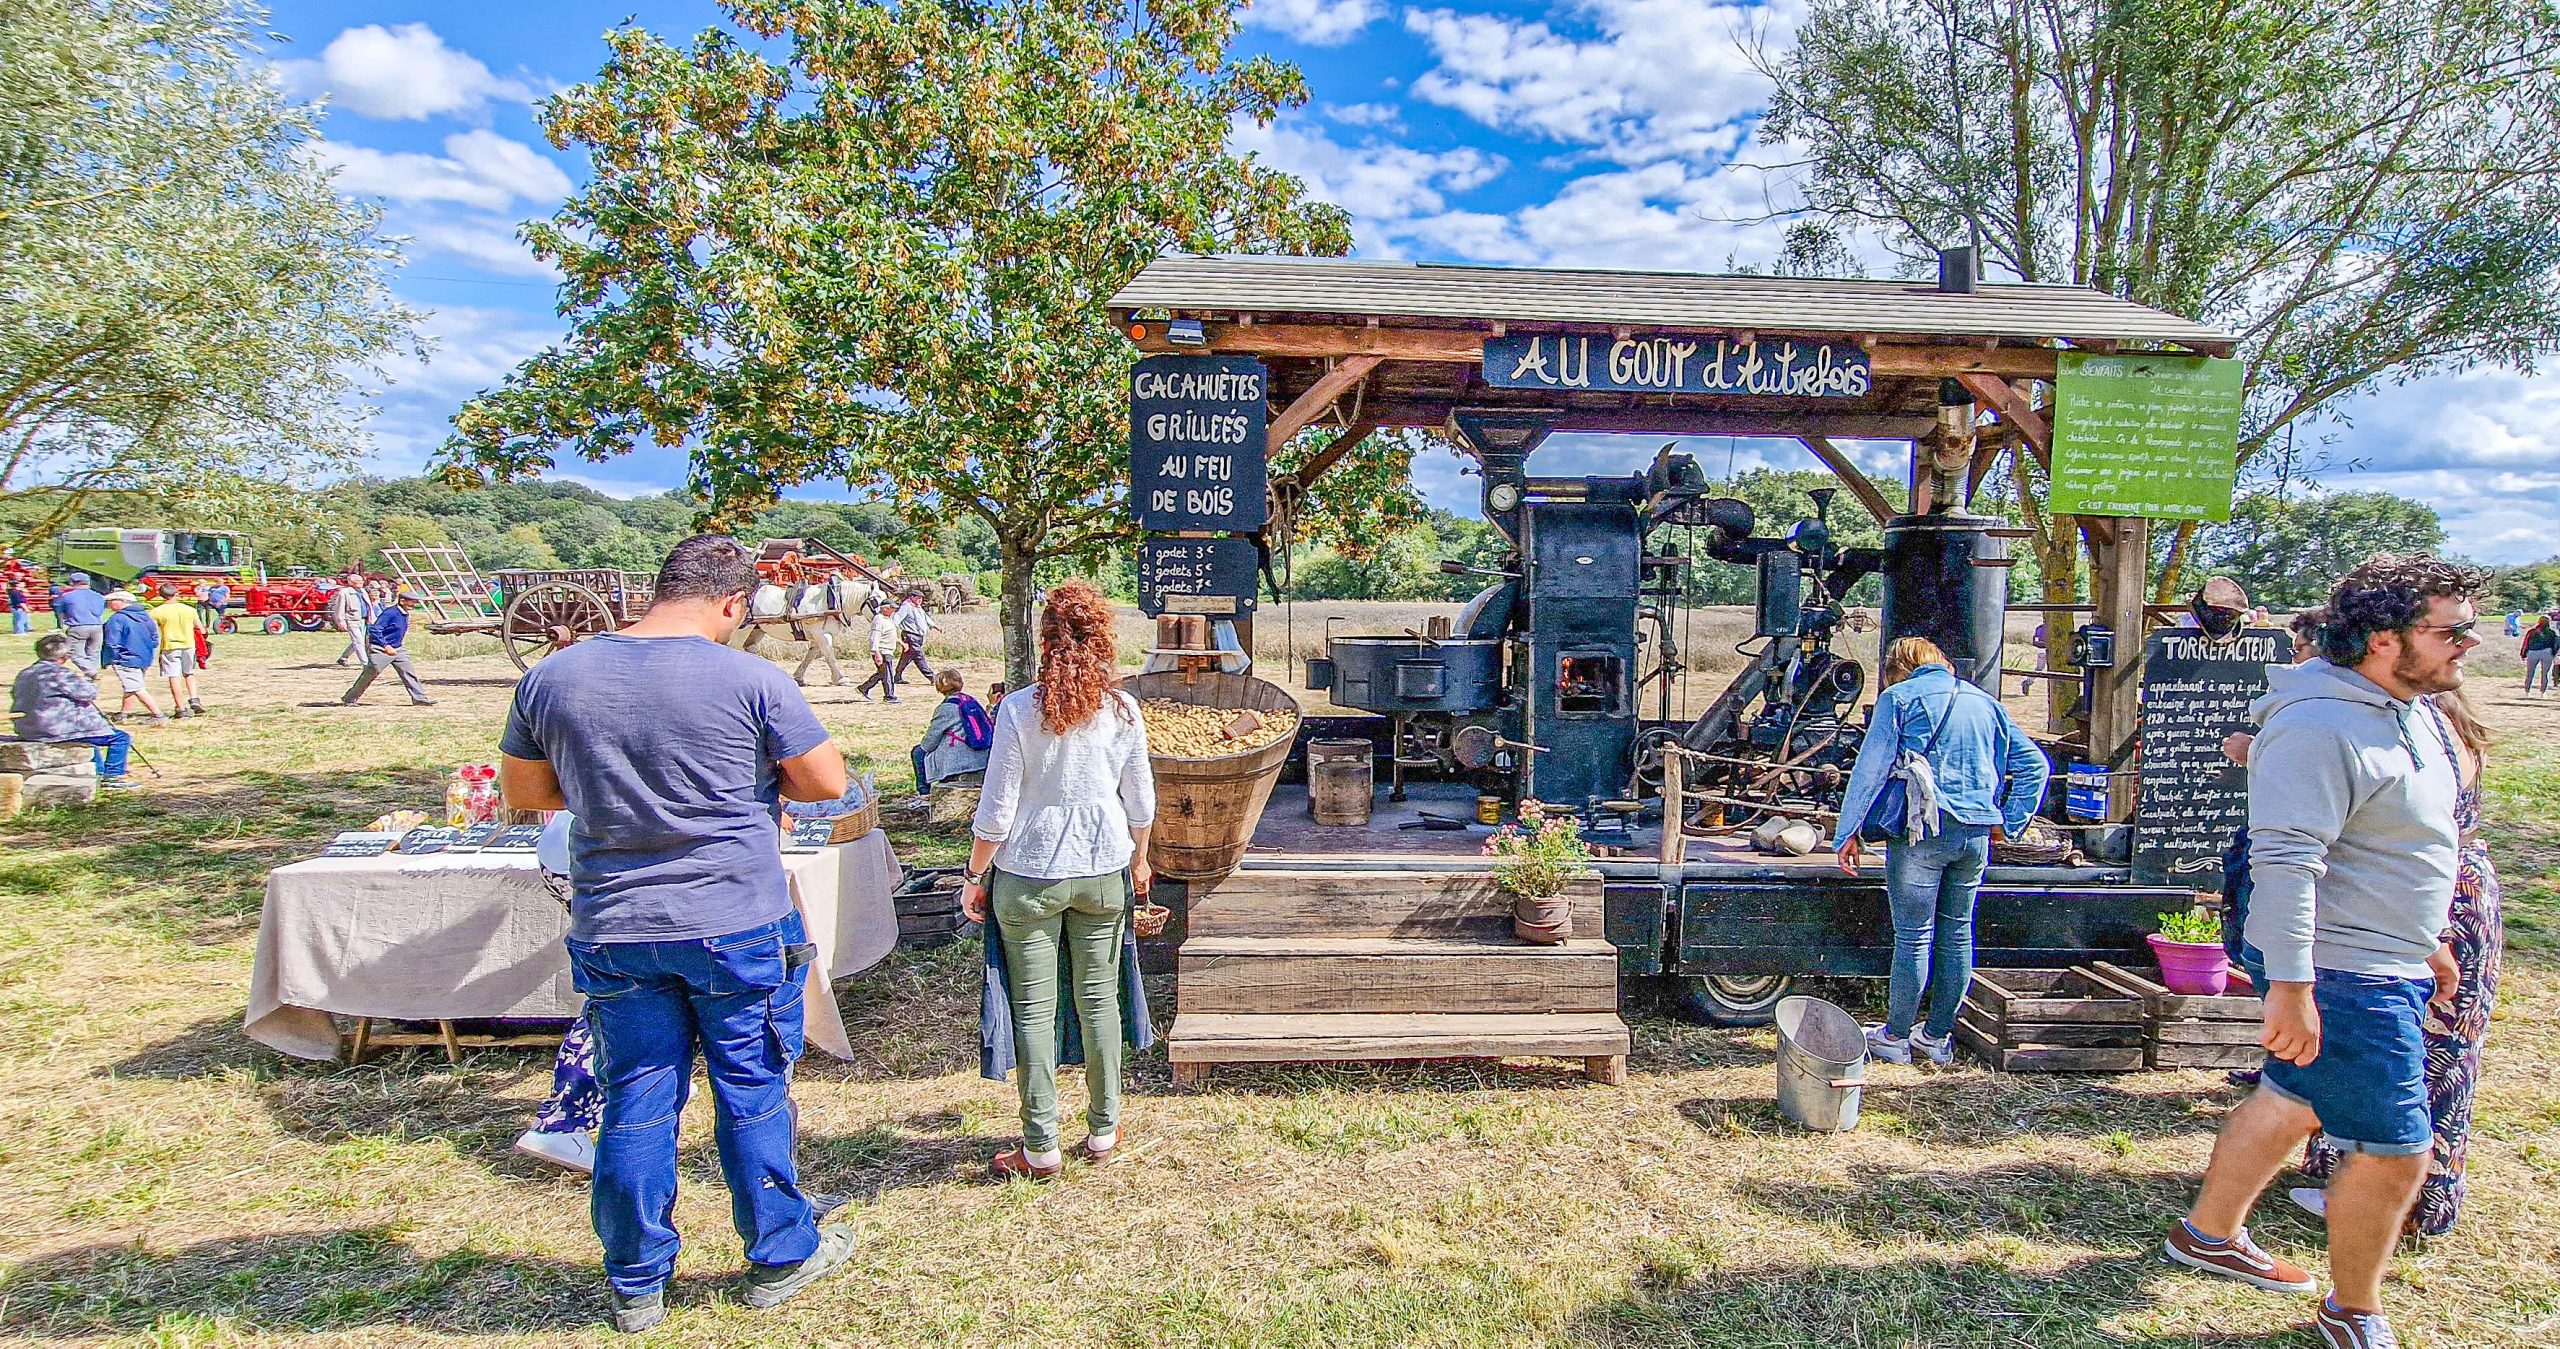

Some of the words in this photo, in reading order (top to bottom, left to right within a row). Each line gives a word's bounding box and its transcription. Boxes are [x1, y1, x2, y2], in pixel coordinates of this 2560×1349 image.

[1510, 336, 1590, 388] AU
[1702, 339, 1869, 397] d'Autrefois
[2080, 362, 2123, 378] BIENFAITS
[1134, 366, 1260, 401] CACAHUÈTES
[1159, 454, 1187, 479] AU
[1194, 454, 1232, 481] FEU
[1152, 489, 1178, 513] DE
[1187, 484, 1234, 516] BOIS
[1141, 546, 1149, 558] 1
[1156, 546, 1188, 566] godet
[1141, 563, 1150, 576] 2
[1154, 564, 1192, 582] godets
[1141, 581, 1150, 593] 3
[1155, 579, 1192, 598] godets
[2150, 678, 2205, 699] appartenant
[2208, 680, 2215, 692] à
[2227, 712, 2237, 722] de
